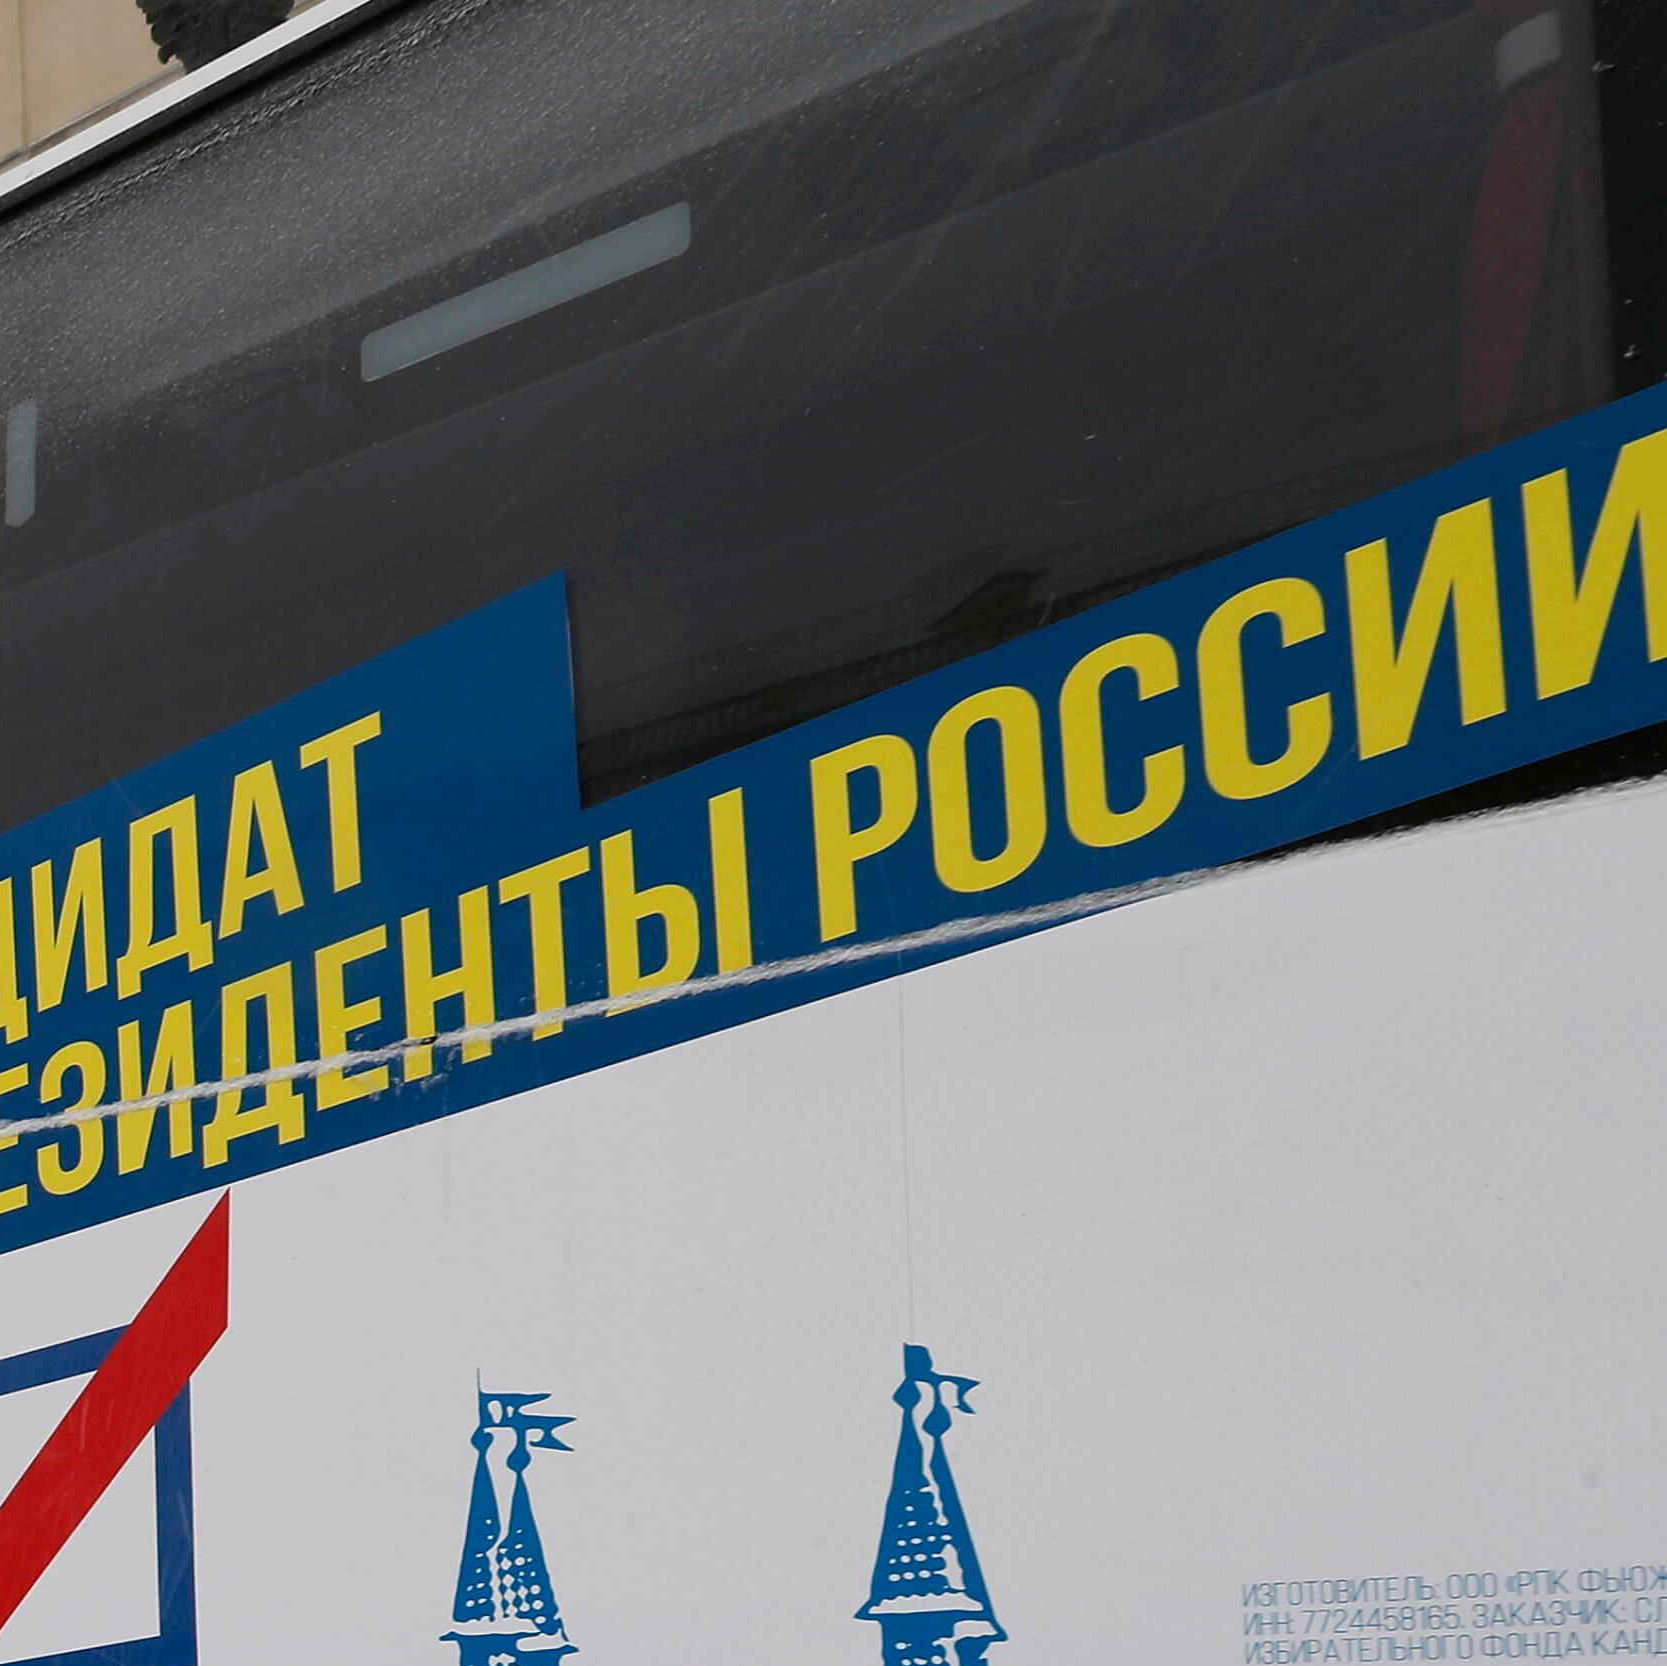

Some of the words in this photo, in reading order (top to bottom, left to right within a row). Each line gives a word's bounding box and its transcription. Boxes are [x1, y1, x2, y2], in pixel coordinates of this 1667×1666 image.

[809, 427, 1667, 944] РОССИИ
[1243, 1576, 1440, 1607] ИЗГОТОВИТЕЛЬ:
[1446, 1572, 1498, 1599] ООО
[1244, 1612, 1294, 1636] ИНН:
[1301, 1604, 1465, 1634] 7724458165.
[1473, 1598, 1627, 1630] ЗАКАЗЧИК:
[1245, 1633, 1473, 1665] ИЗБИРАТЕЛЬНОГО
[1481, 1630, 1584, 1660] ФОНДА
